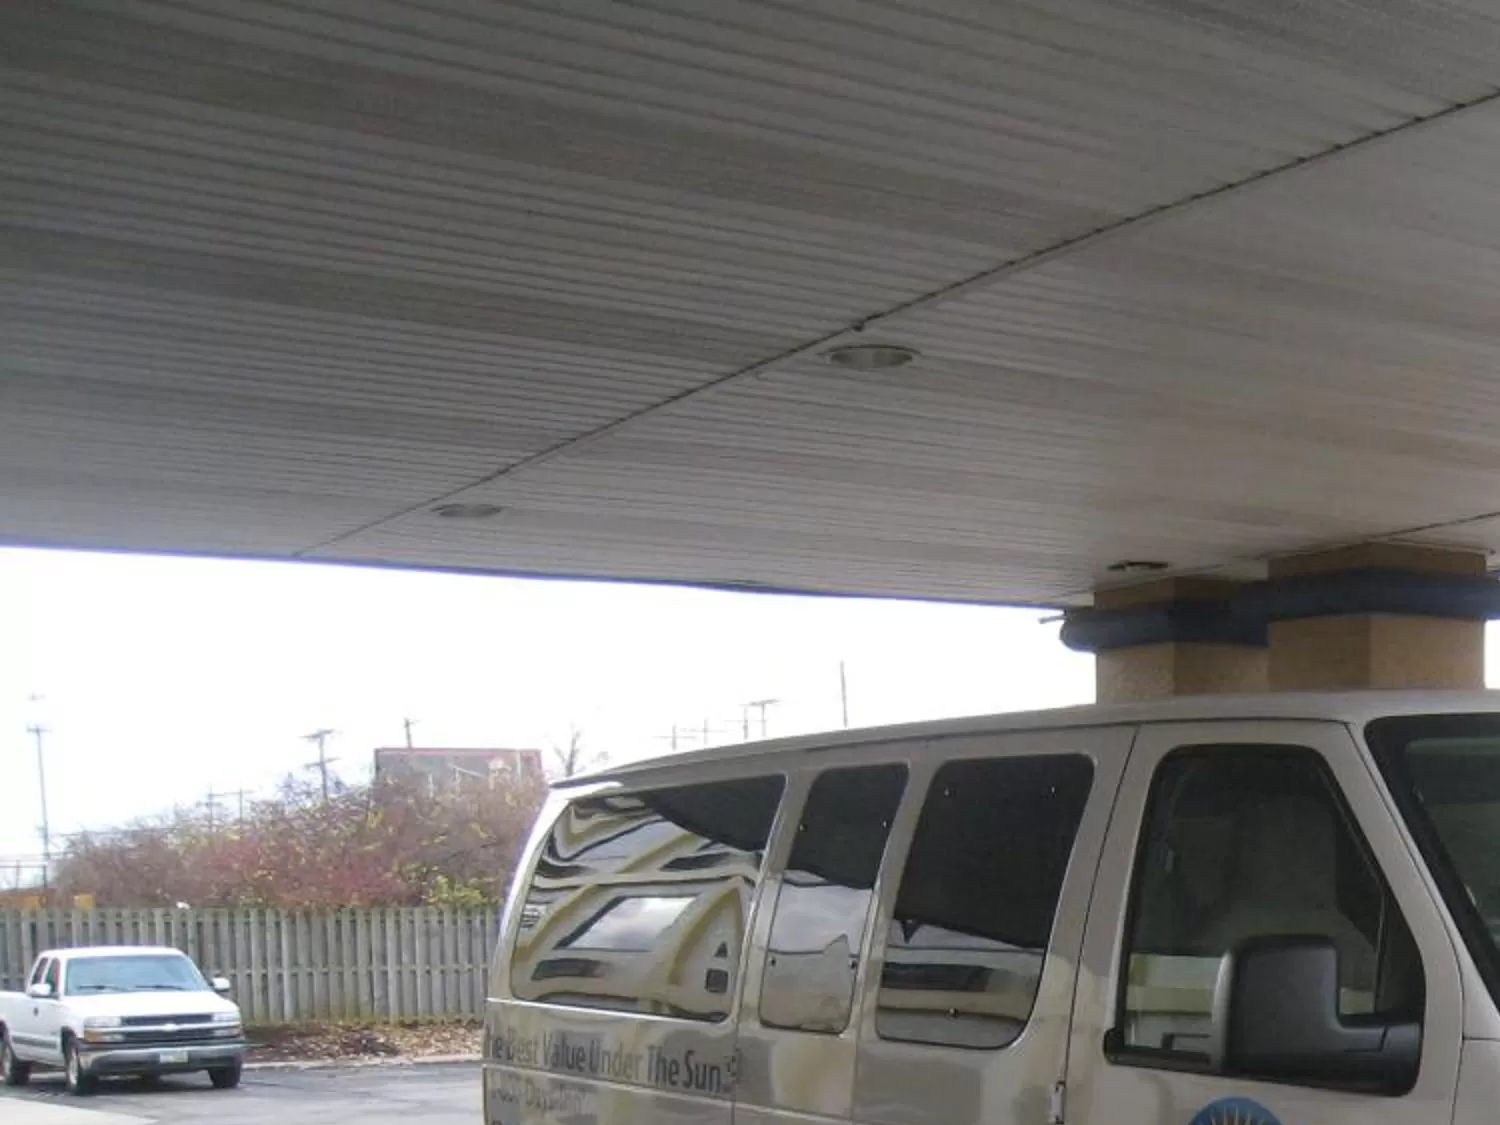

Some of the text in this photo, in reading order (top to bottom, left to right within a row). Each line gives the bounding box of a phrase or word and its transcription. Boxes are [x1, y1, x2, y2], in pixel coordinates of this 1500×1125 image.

[544, 1031, 587, 1072] Value
[589, 1039, 643, 1082] Under
[647, 1045, 680, 1088] The
